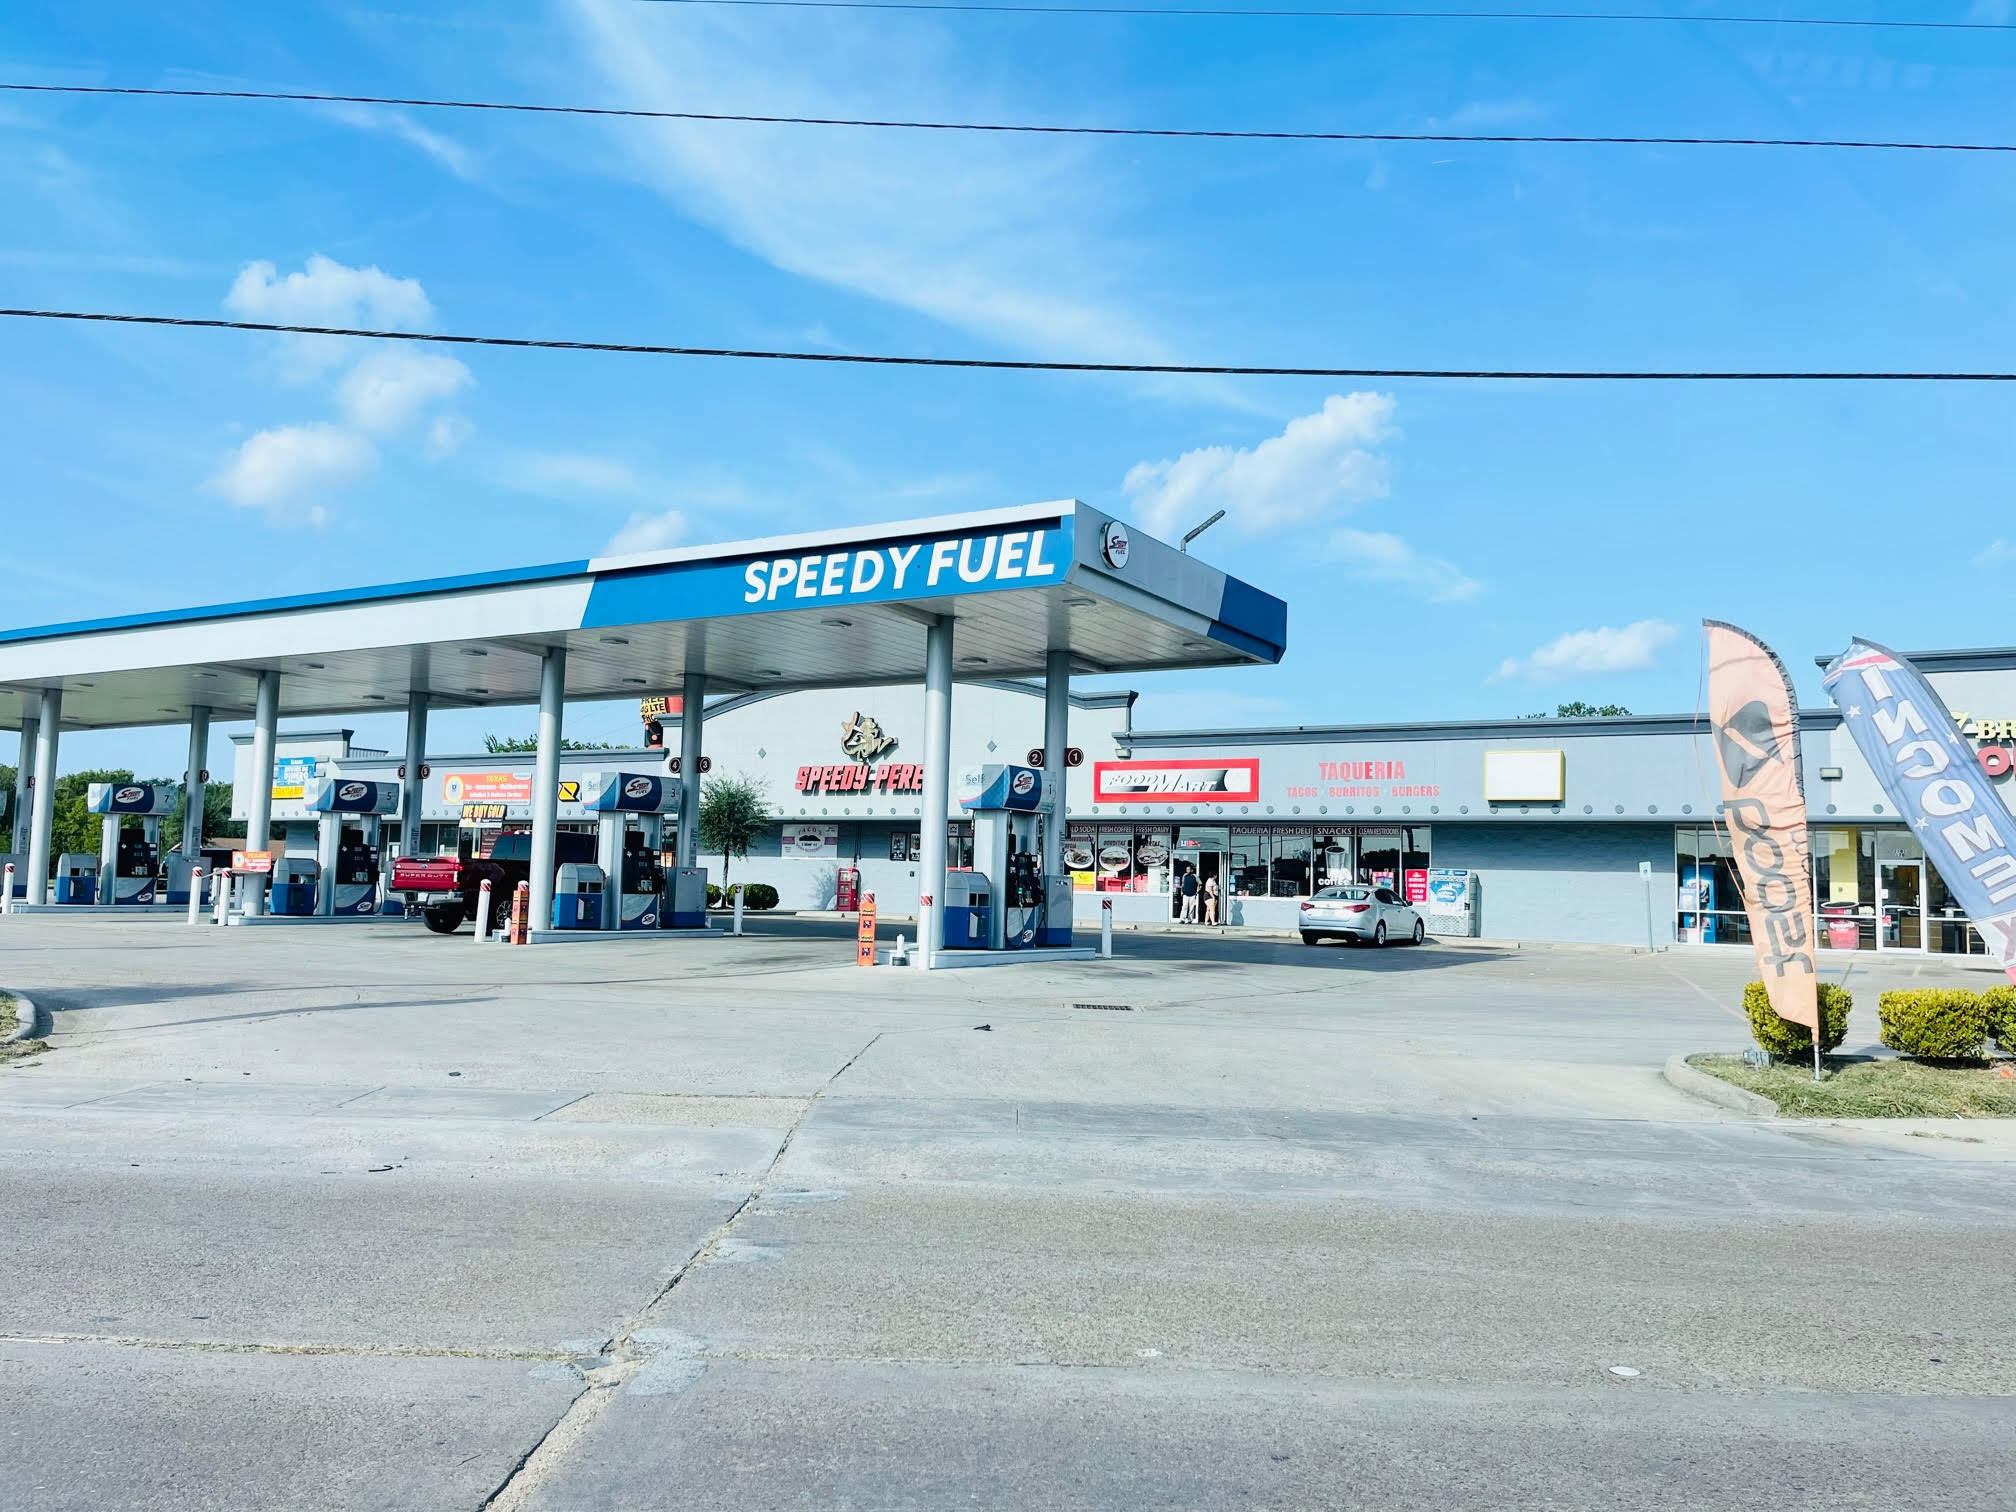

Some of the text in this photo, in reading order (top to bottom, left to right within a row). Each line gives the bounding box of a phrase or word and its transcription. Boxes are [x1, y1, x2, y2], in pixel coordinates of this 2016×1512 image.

[744, 530, 1054, 603] SPEEDY FUEL
[649, 703, 665, 712] LTE
[1031, 753, 1038, 762] 2
[1073, 752, 1078, 762] 1
[671, 761, 677, 769] 4
[702, 761, 708, 769] 3
[1318, 761, 1405, 781] TAQUERIA
[795, 764, 923, 790] SPEEDY PERE
[965, 773, 985, 785] Self
[386, 791, 392, 800] 5
[670, 788, 676, 798] 3
[1287, 785, 1440, 798] TACOS BURRITOS BURGERS
[164, 794, 170, 803] 7
[463, 804, 506, 818] WE BUY GOLD
[1232, 827, 1268, 835] TAQUERIA
[1272, 827, 1311, 835] FRESH DELI
[1317, 827, 1352, 835] SNACKS
[1358, 827, 1374, 835] CLEAN
[1318, 877, 1351, 887] coffee
